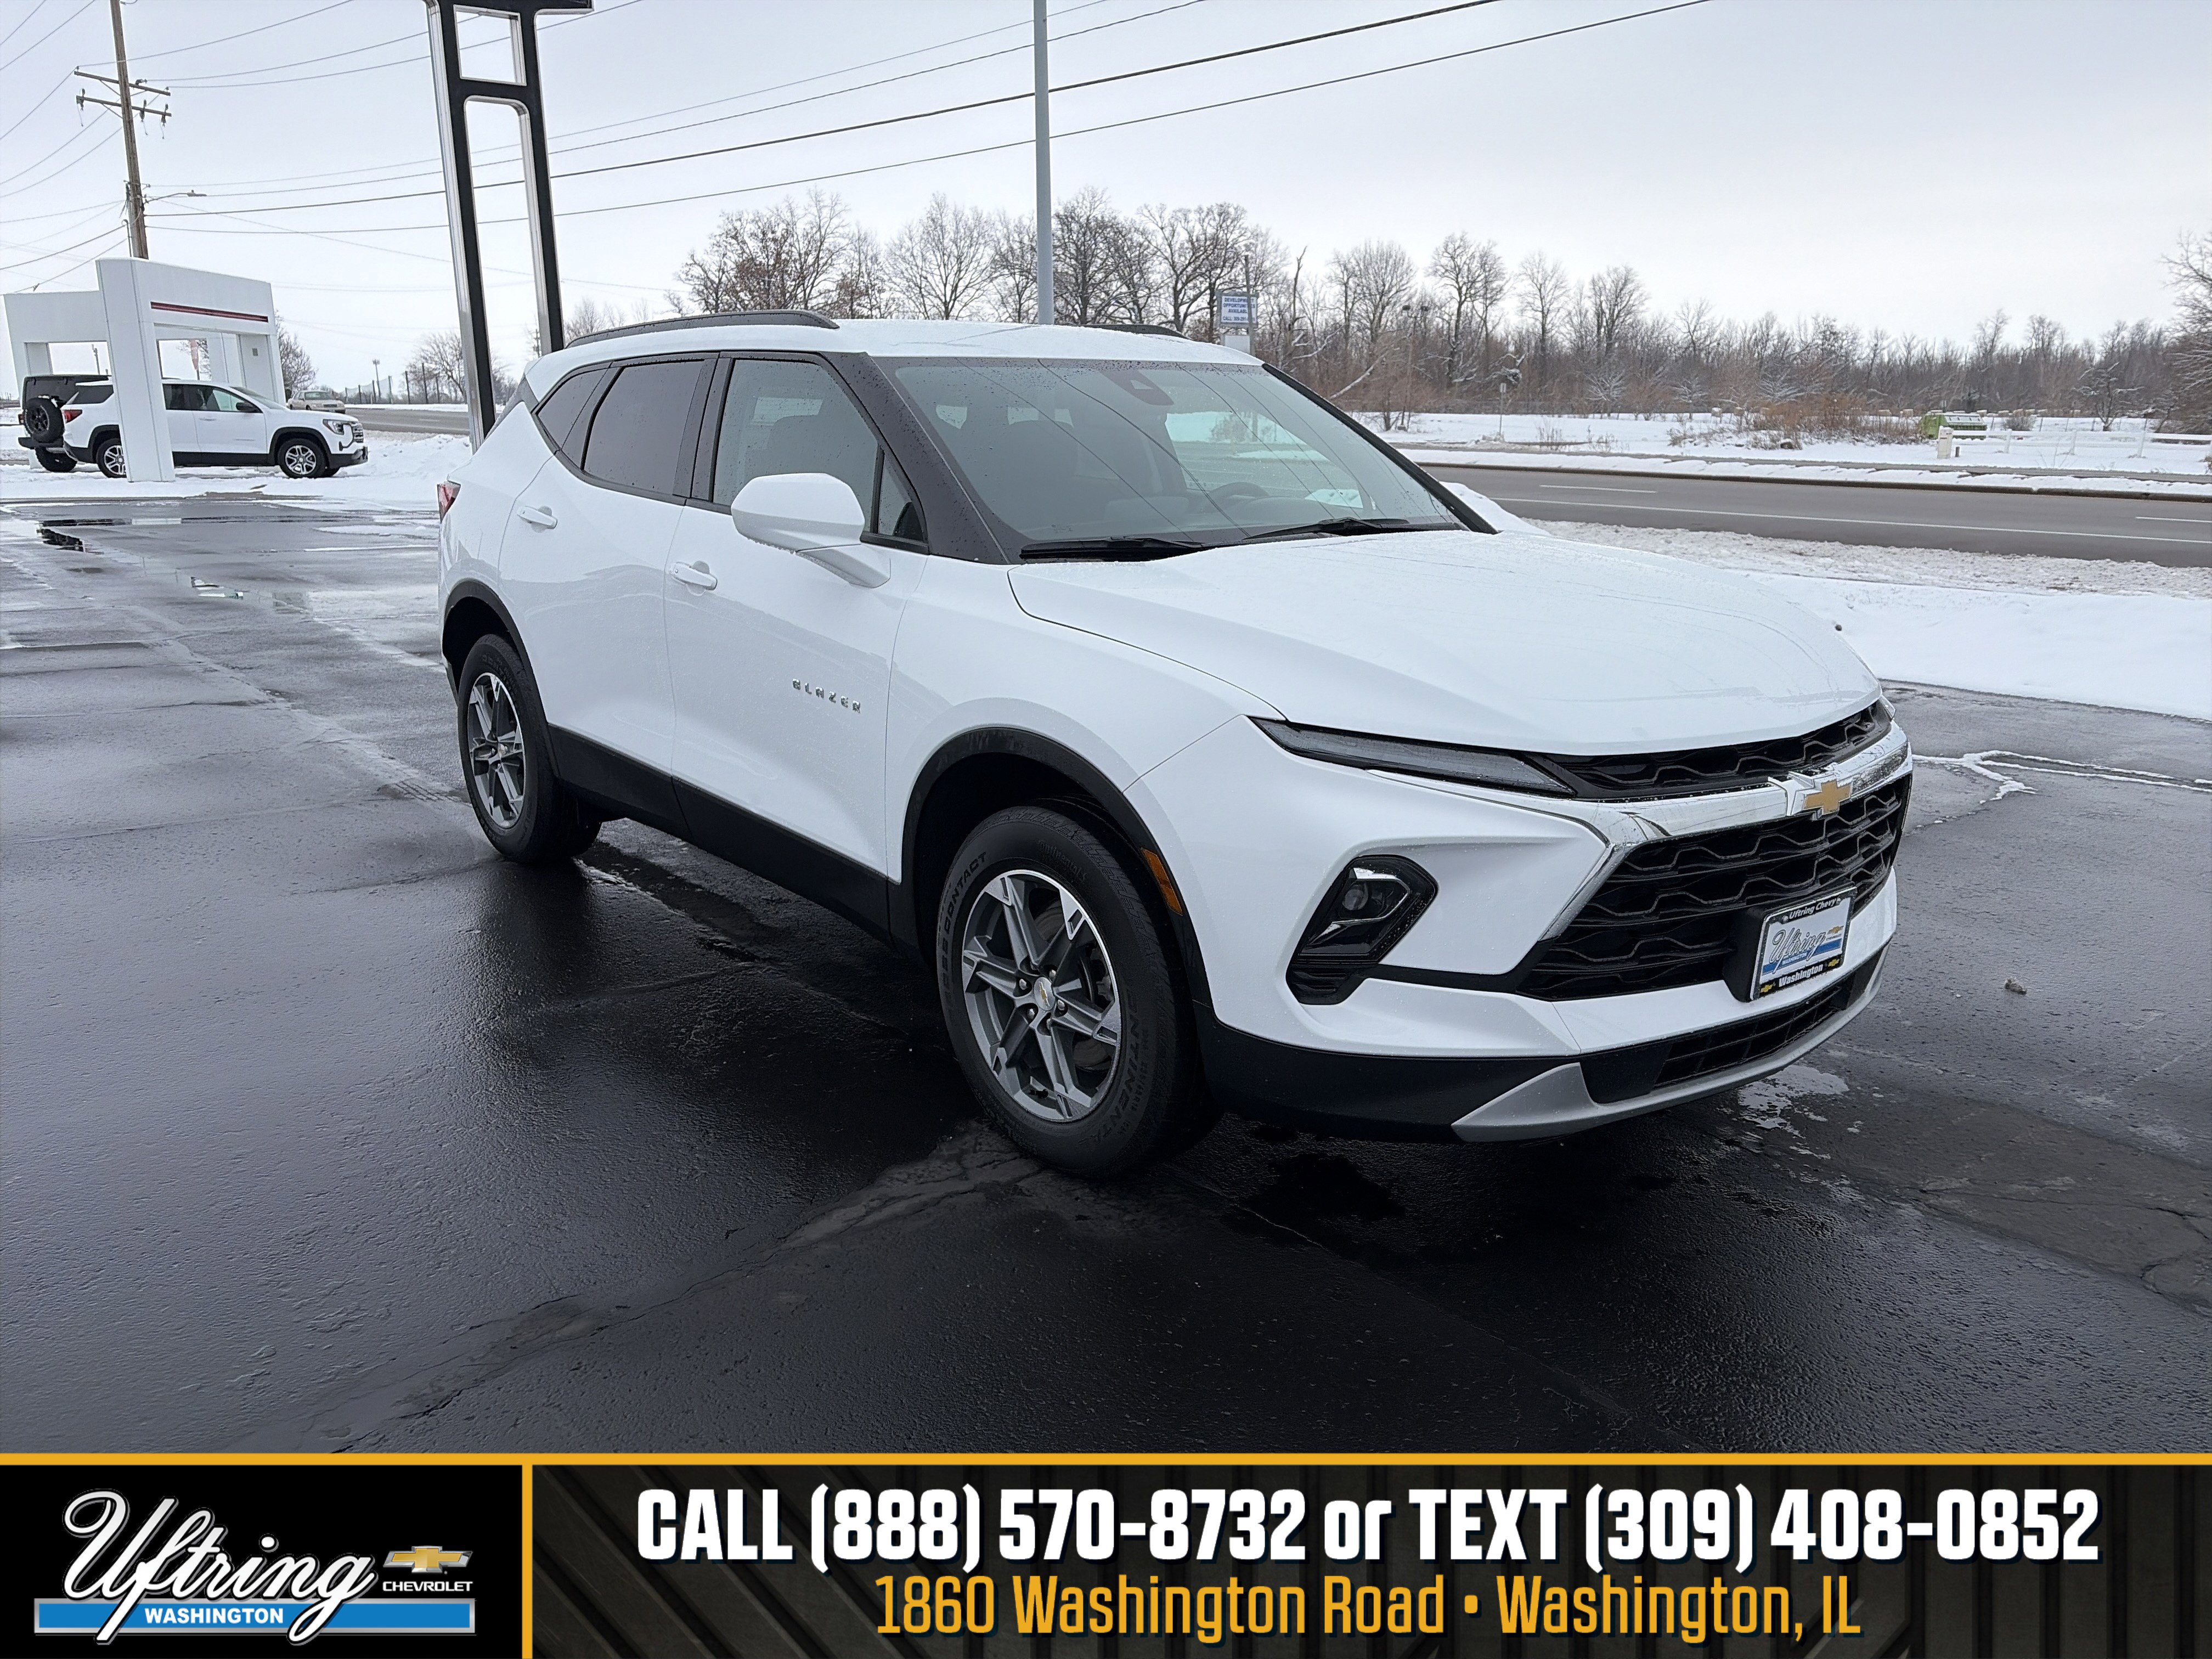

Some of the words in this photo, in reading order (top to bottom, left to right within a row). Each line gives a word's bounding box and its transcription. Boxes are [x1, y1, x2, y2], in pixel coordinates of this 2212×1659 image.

[792, 678, 861, 713] BLAZER
[944, 851, 987, 934] CONTACT
[1789, 906, 1815, 919] Uftring
[1815, 898, 1837, 911] Chevy
[1779, 964, 1824, 988] Washington
